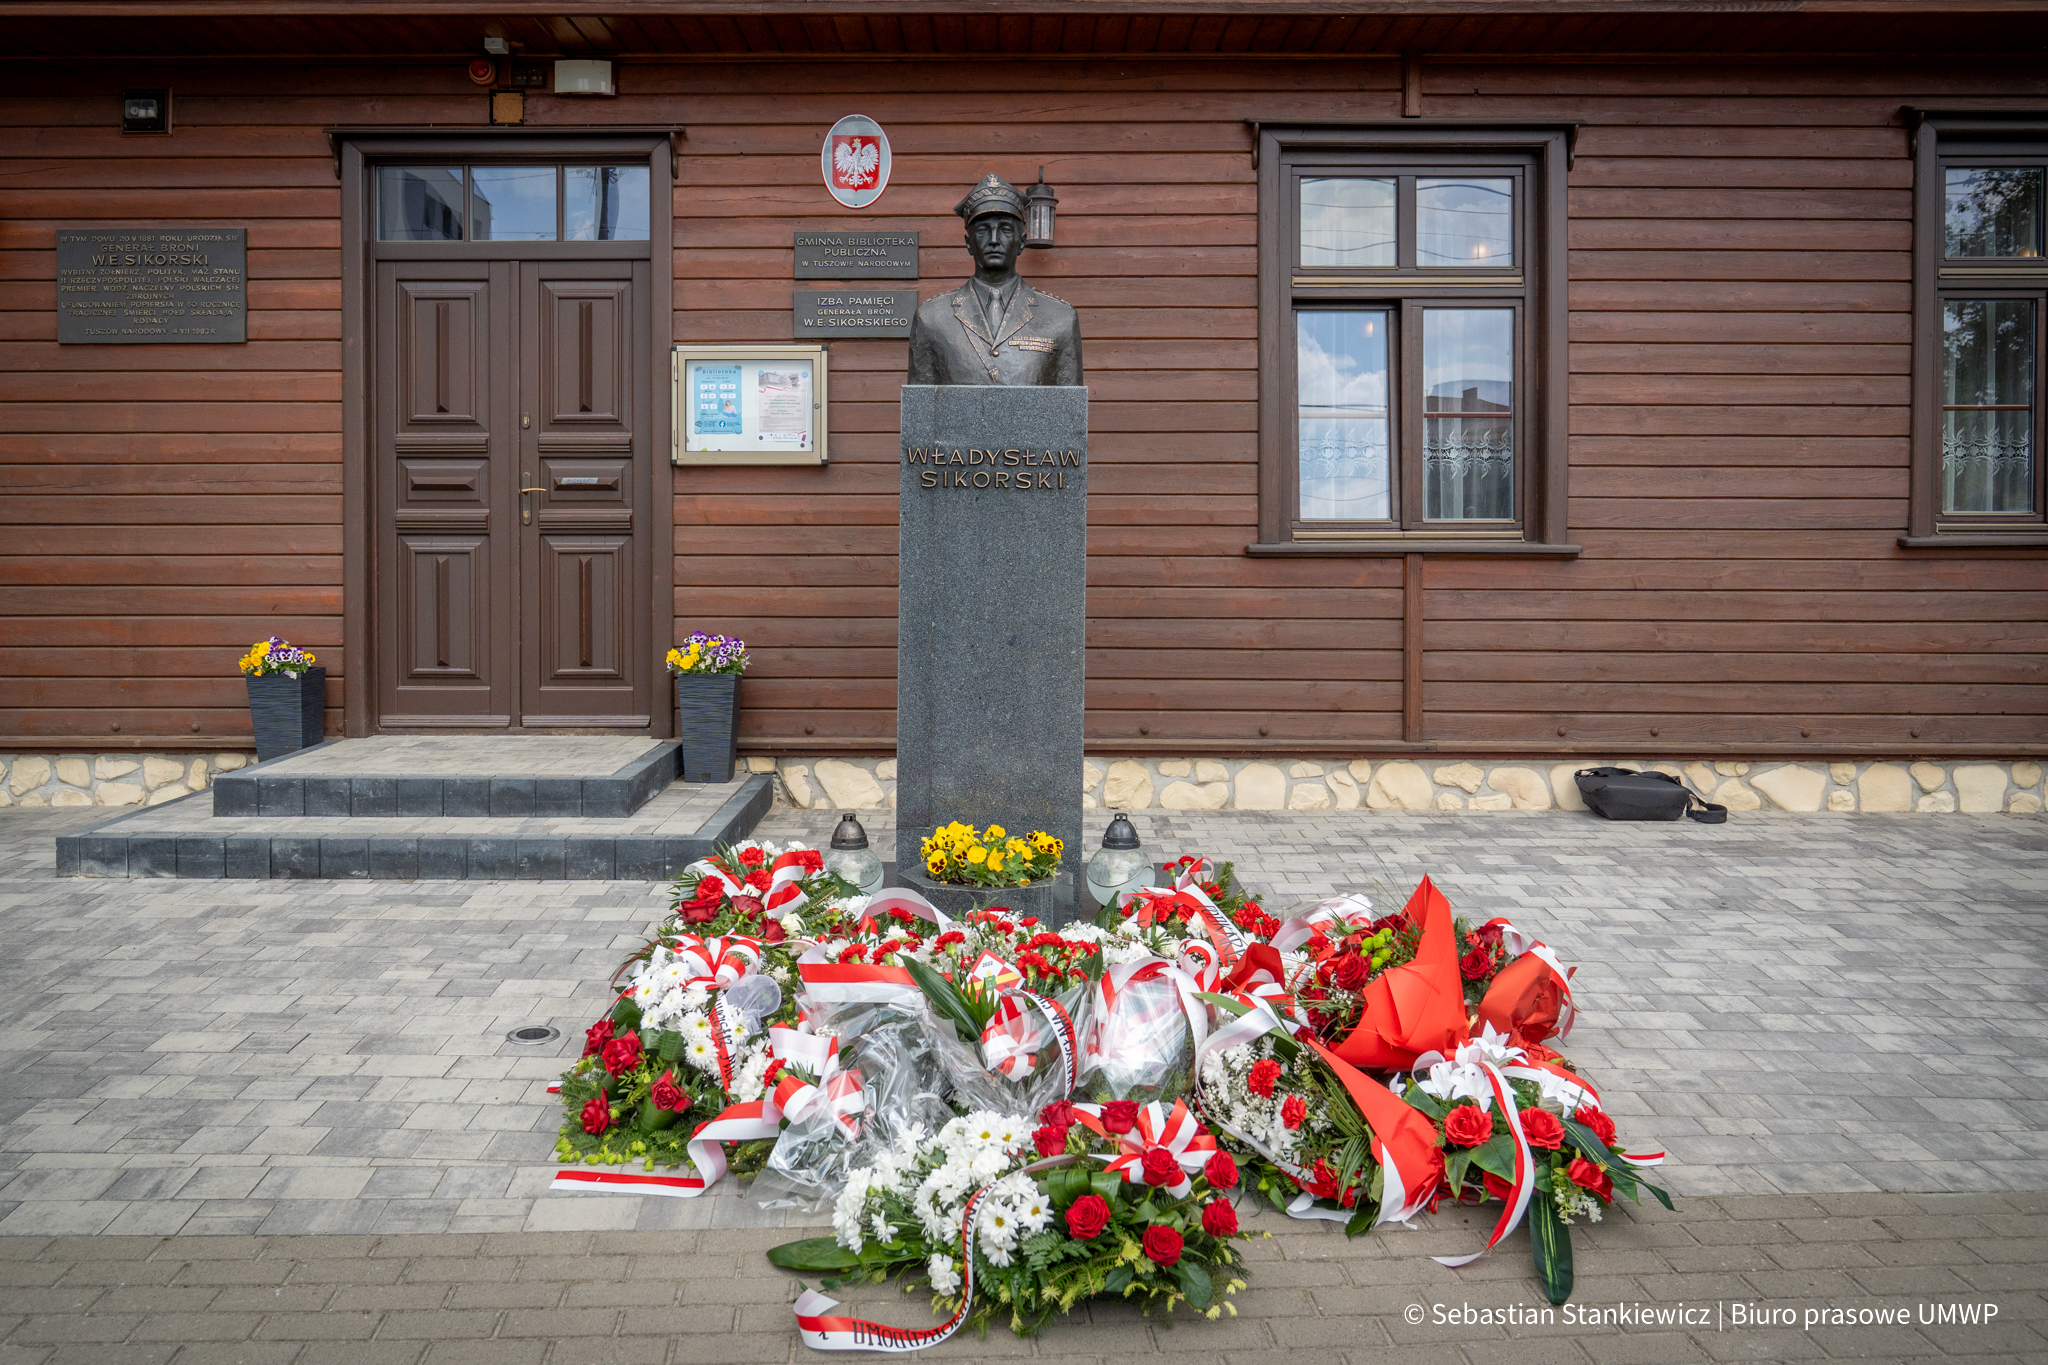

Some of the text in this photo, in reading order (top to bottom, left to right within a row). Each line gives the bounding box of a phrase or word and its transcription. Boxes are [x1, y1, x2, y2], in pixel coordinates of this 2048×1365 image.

[796, 237, 916, 246] GMINNA BIBLIOTEKA
[101, 244, 199, 252] GENERAŁ BRONI
[824, 248, 887, 256] PUBLICZNA
[125, 254, 208, 266] SIKORSKI
[817, 296, 894, 308] IZBA PAMIĘCI
[828, 318, 908, 327] SIKORSKIEGO
[907, 448, 1080, 468] WŁADYSŁAW
[921, 470, 1064, 490] SIKORSKI
